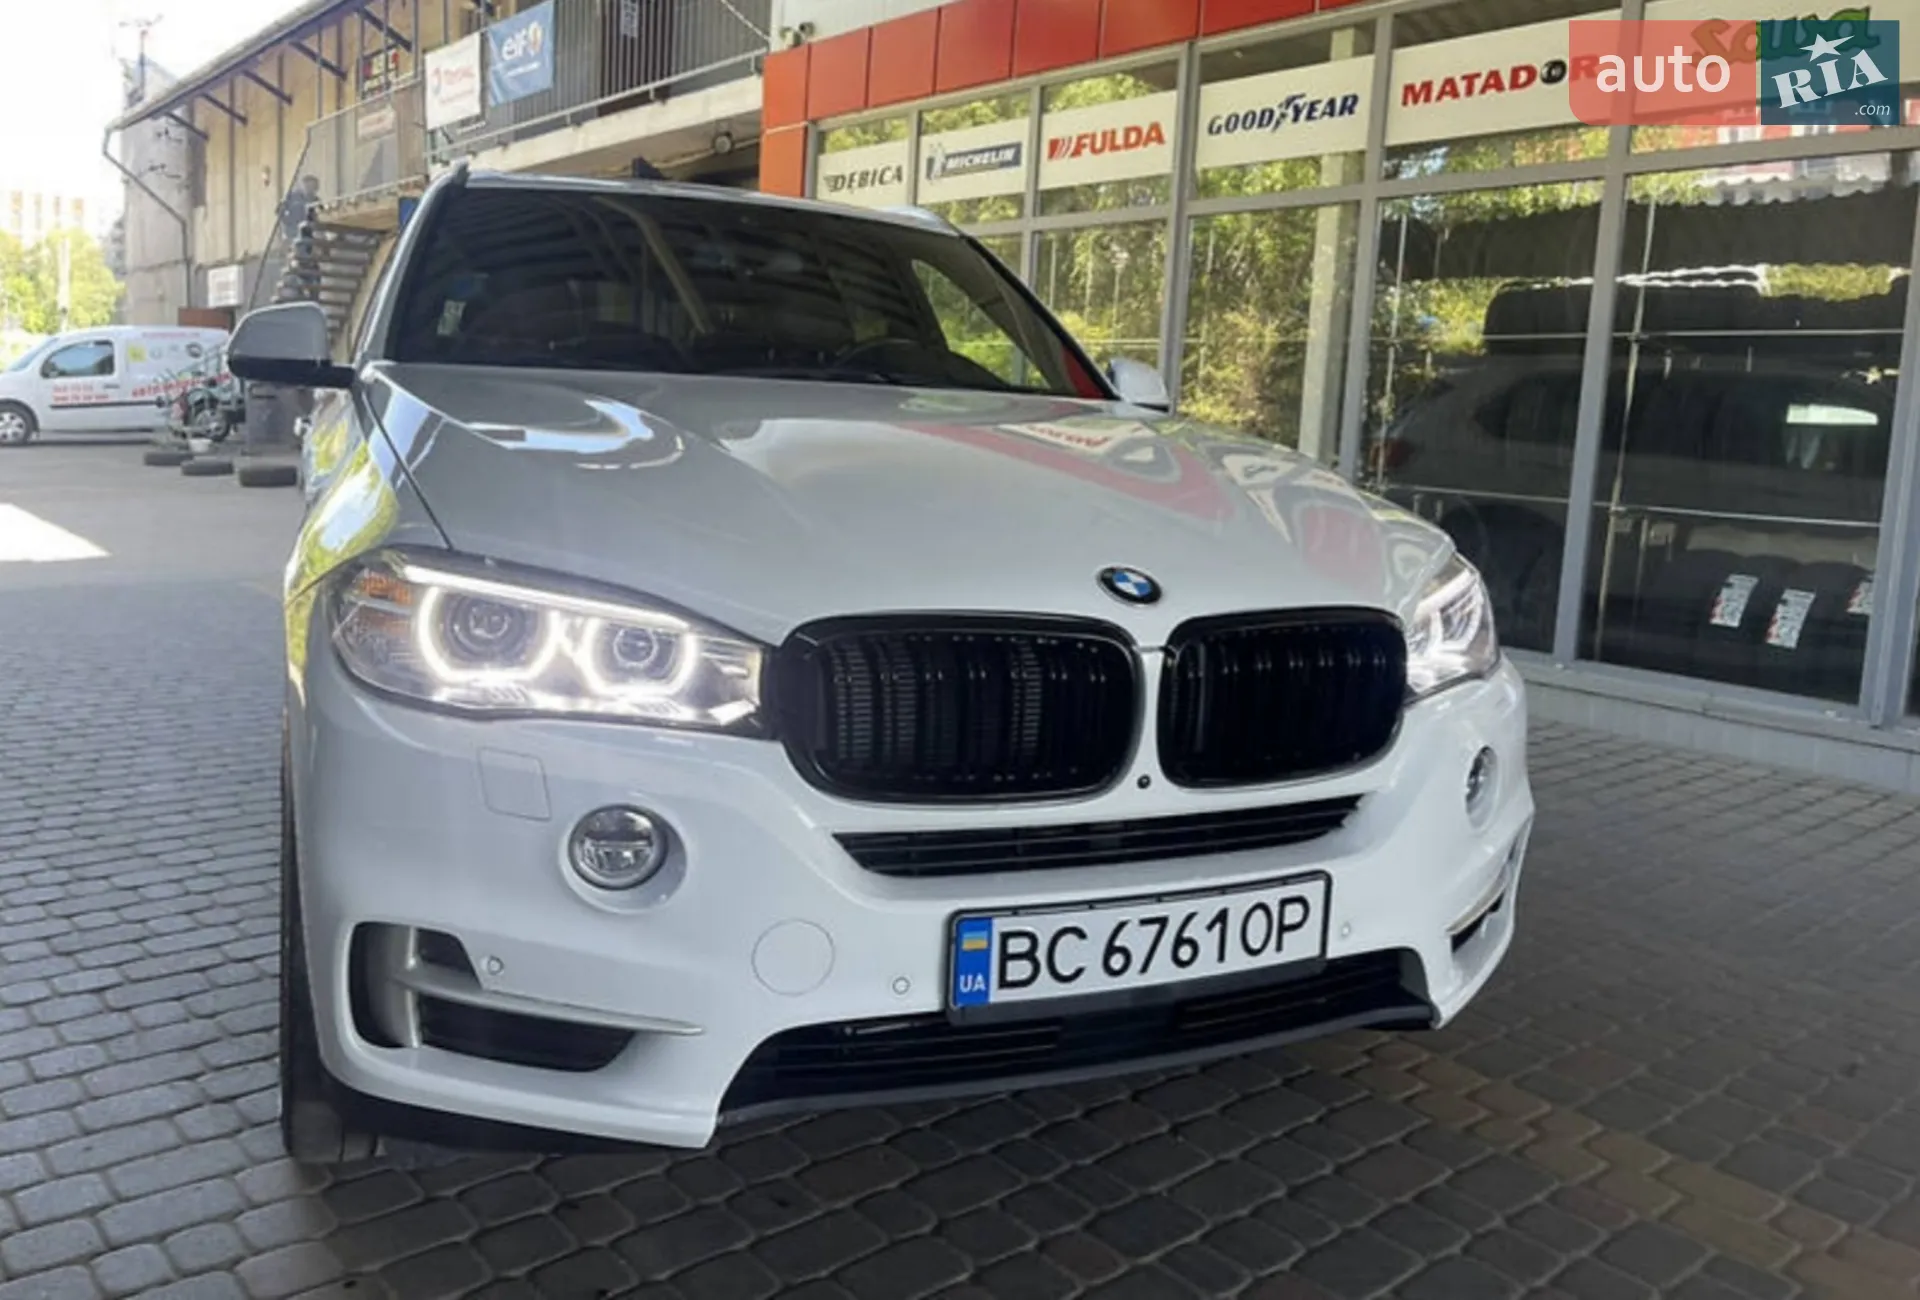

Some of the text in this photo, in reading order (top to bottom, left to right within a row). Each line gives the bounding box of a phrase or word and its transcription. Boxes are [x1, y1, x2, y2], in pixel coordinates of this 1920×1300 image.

[1400, 54, 1598, 107] MATADOR
[1207, 92, 1359, 137] GOODYEAR
[946, 147, 1016, 171] MICHELIN
[1070, 121, 1166, 158] FULDA
[997, 894, 1311, 991] BC 6761 OP
[959, 973, 986, 993] UA
